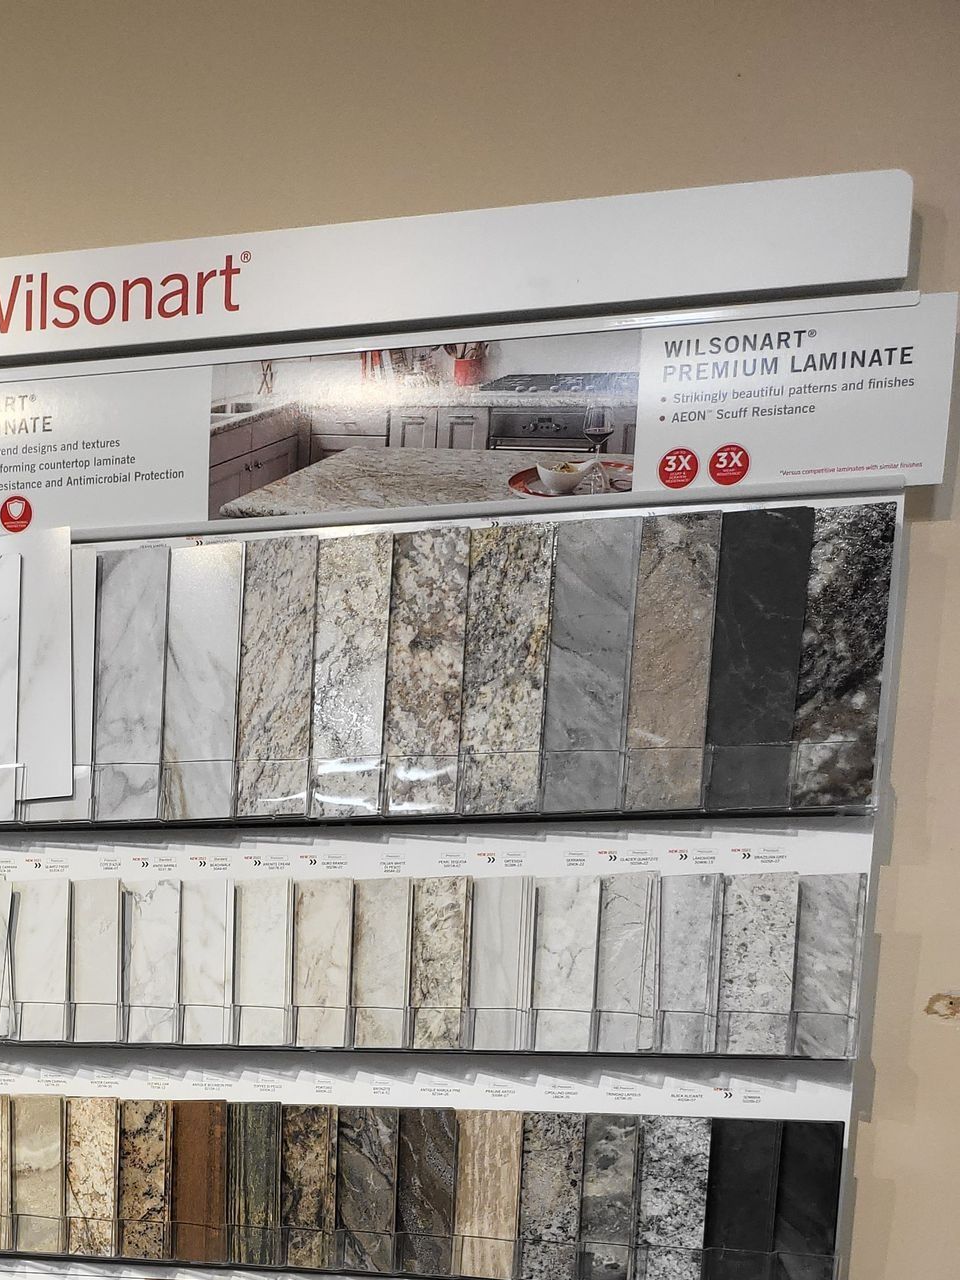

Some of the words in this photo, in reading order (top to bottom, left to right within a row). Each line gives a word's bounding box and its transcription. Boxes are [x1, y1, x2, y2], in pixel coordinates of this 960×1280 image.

[662, 357, 778, 383] PREMIUM
[790, 346, 914, 374] LAMINATE
[673, 390, 728, 404] Strikingly
[732, 385, 784, 400] beautiful
[788, 382, 838, 397] patterns
[841, 379, 864, 391] and
[868, 376, 915, 389] finishes
[716, 408, 748, 420] Scuff
[751, 402, 816, 418] Resistance
[21, 441, 58, 457] designs
[60, 440, 79, 451] and
[82, 438, 121, 450] textures
[39, 456, 90, 472] countertop
[93, 454, 136, 467] laminate
[664, 454, 692, 472] 3X
[715, 451, 744, 469] 3X
[45, 475, 63, 488] and
[66, 472, 131, 487] Antimicrobial
[134, 468, 184, 482] Protection
